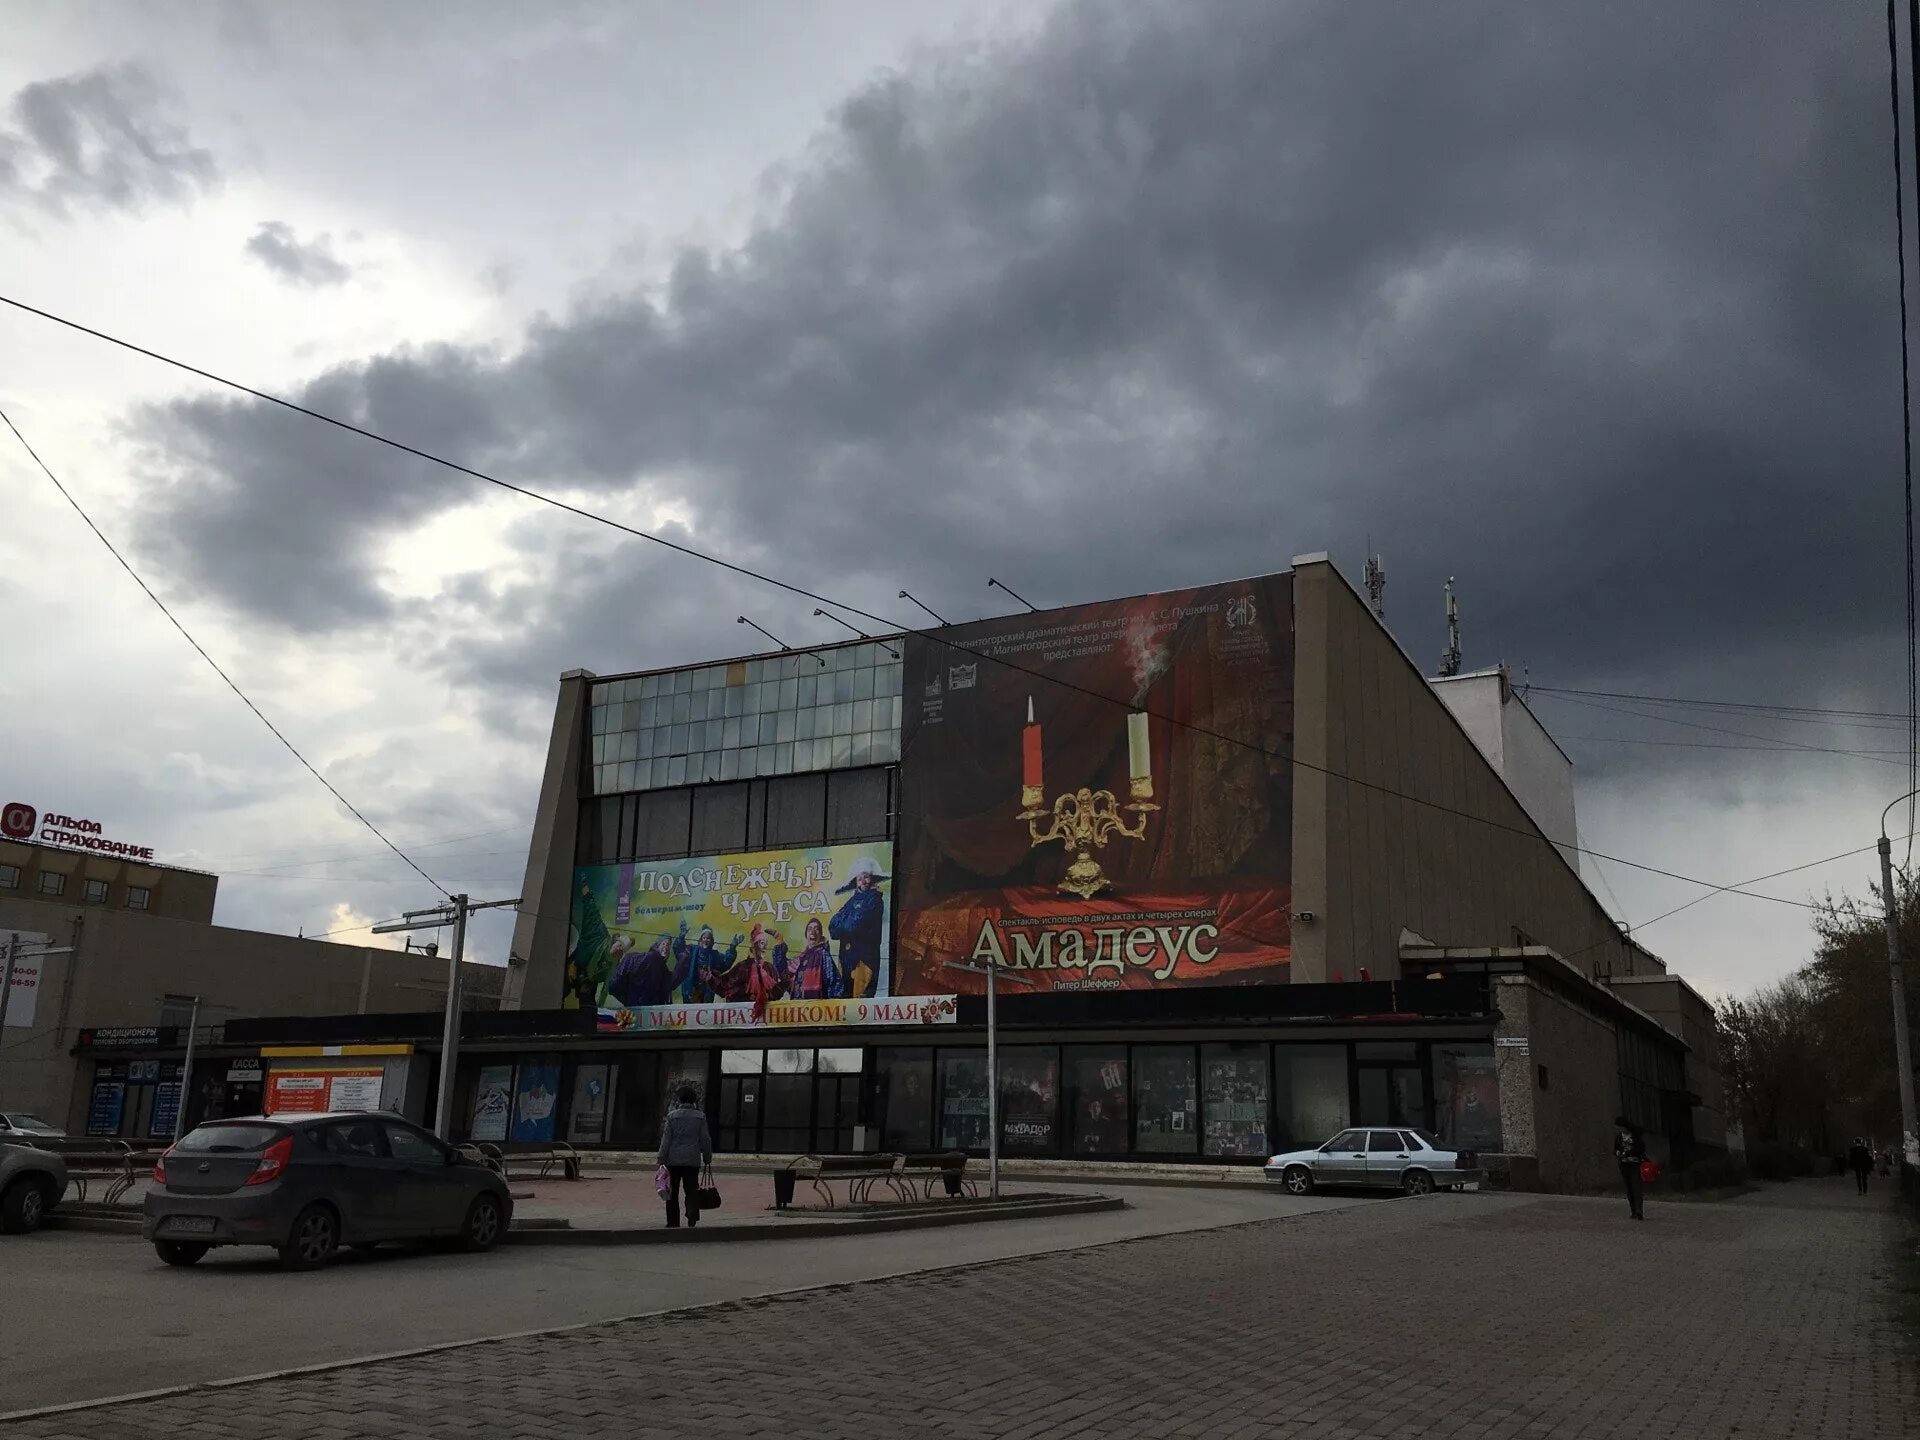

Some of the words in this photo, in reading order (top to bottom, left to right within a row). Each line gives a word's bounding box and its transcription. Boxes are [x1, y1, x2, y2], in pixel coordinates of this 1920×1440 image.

[950, 630, 1025, 651] Магнитогорский
[1027, 619, 1099, 640] драматический
[1102, 617, 1128, 629] театр
[1171, 602, 1219, 620] Пушкина
[993, 635, 1070, 656] Магнитогорский
[1073, 632, 1099, 644] театр
[1101, 628, 1128, 640] опер
[44, 813, 102, 834] АЛЬФА
[41, 829, 154, 859] СТРАХОВАНИЕ
[638, 860, 832, 898] ПОДСНЕЖНЫЕ
[722, 891, 831, 922] ЧУДЕСА
[1092, 913, 1111, 924] двух
[1112, 912, 1136, 921] актах
[1145, 911, 1182, 922] четырех
[1184, 909, 1217, 920] операх
[970, 918, 1219, 981] Амадеус
[1053, 981, 1079, 991] Питер
[1081, 979, 1121, 990] Шеффер
[650, 1011, 687, 1026] МАЯ
[696, 1009, 708, 1026] С
[858, 1004, 868, 1021] 9
[873, 1003, 917, 1021] МАЯ
[96, 1027, 157, 1039] КОНДИЦИОНЕРЫ
[232, 1058, 260, 1069] КАССА
